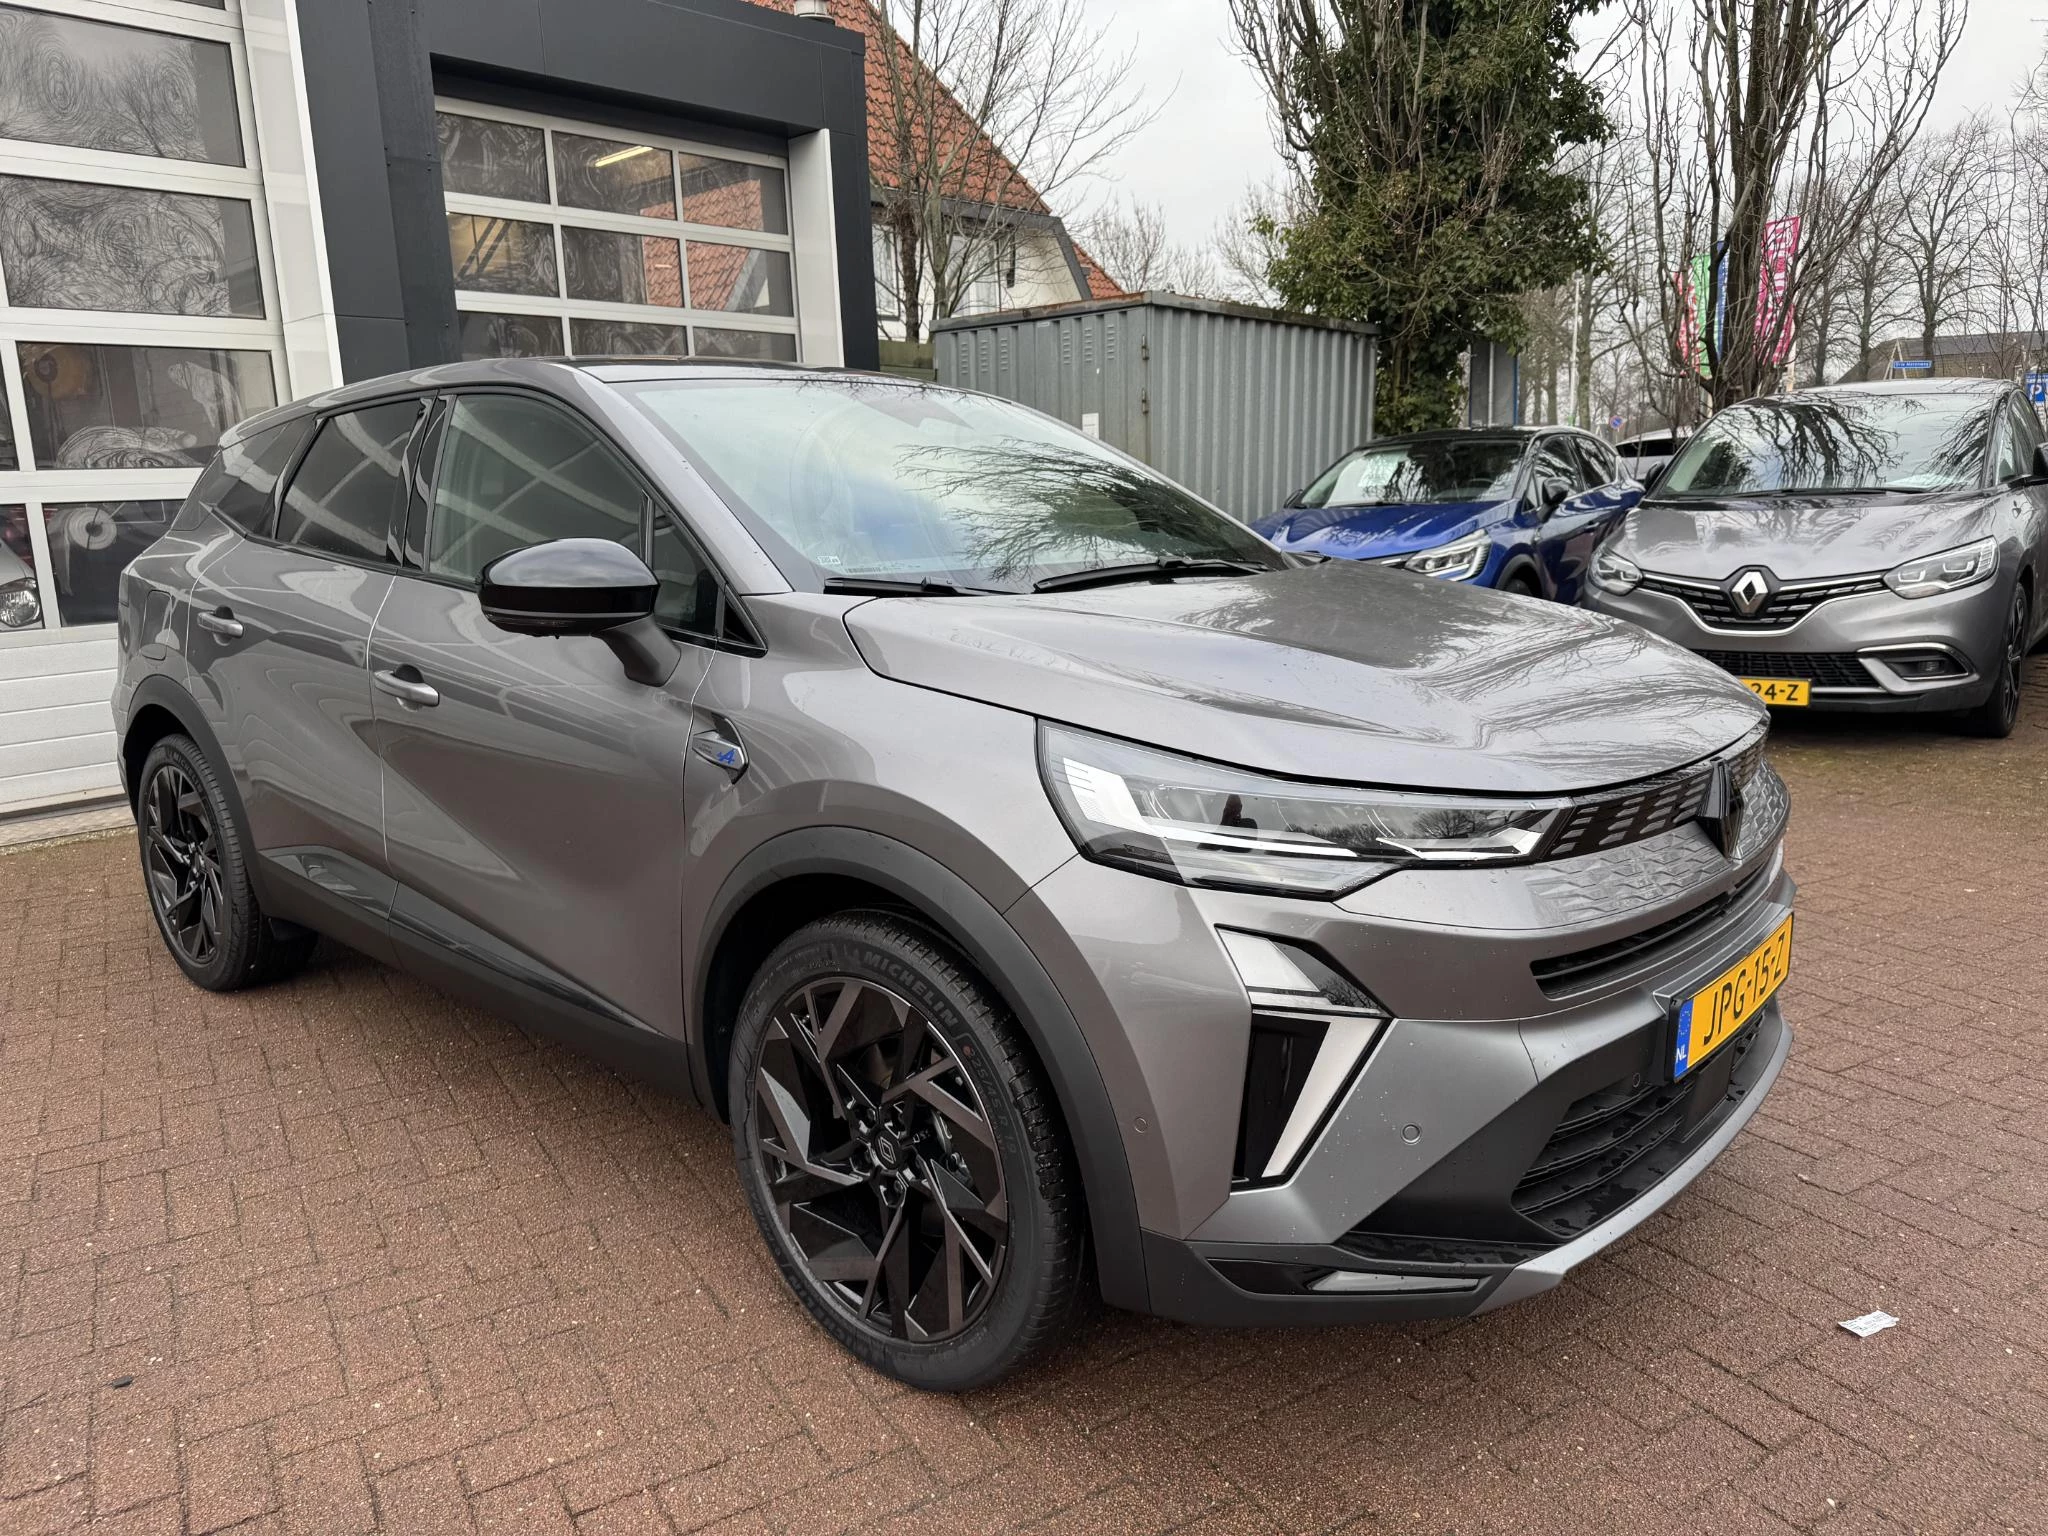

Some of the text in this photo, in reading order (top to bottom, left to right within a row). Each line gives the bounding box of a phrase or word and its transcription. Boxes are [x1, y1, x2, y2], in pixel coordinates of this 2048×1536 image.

[2030, 384, 2042, 401] P
[863, 951, 959, 1028] MICHELIN
[1703, 930, 1786, 1046] JPG-15-Z
[1675, 1047, 1687, 1063] NL
